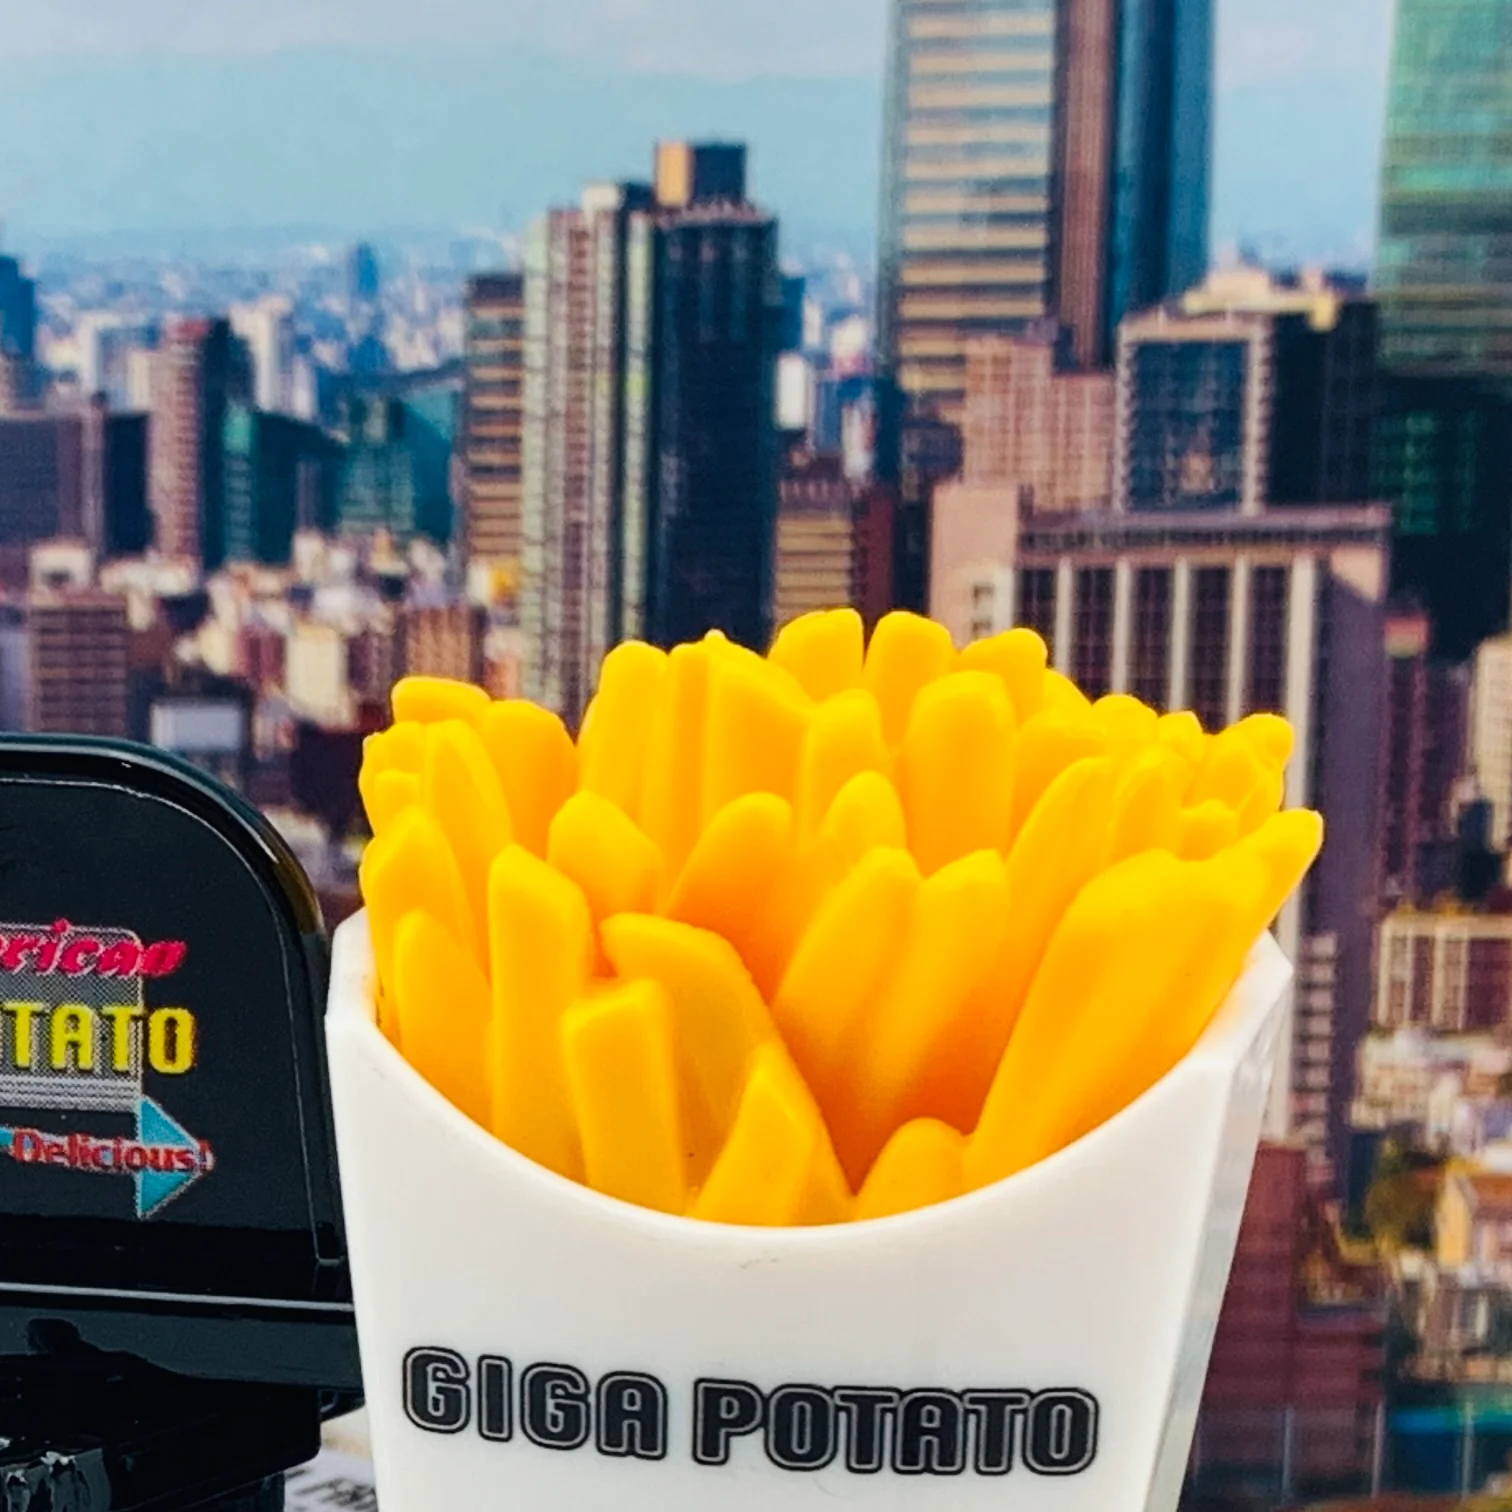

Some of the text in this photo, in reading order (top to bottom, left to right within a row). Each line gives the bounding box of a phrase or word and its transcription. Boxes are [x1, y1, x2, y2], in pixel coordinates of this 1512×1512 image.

[11, 1127, 215, 1178] Delicious!
[402, 1346, 1100, 1476] GIGA POTATO
